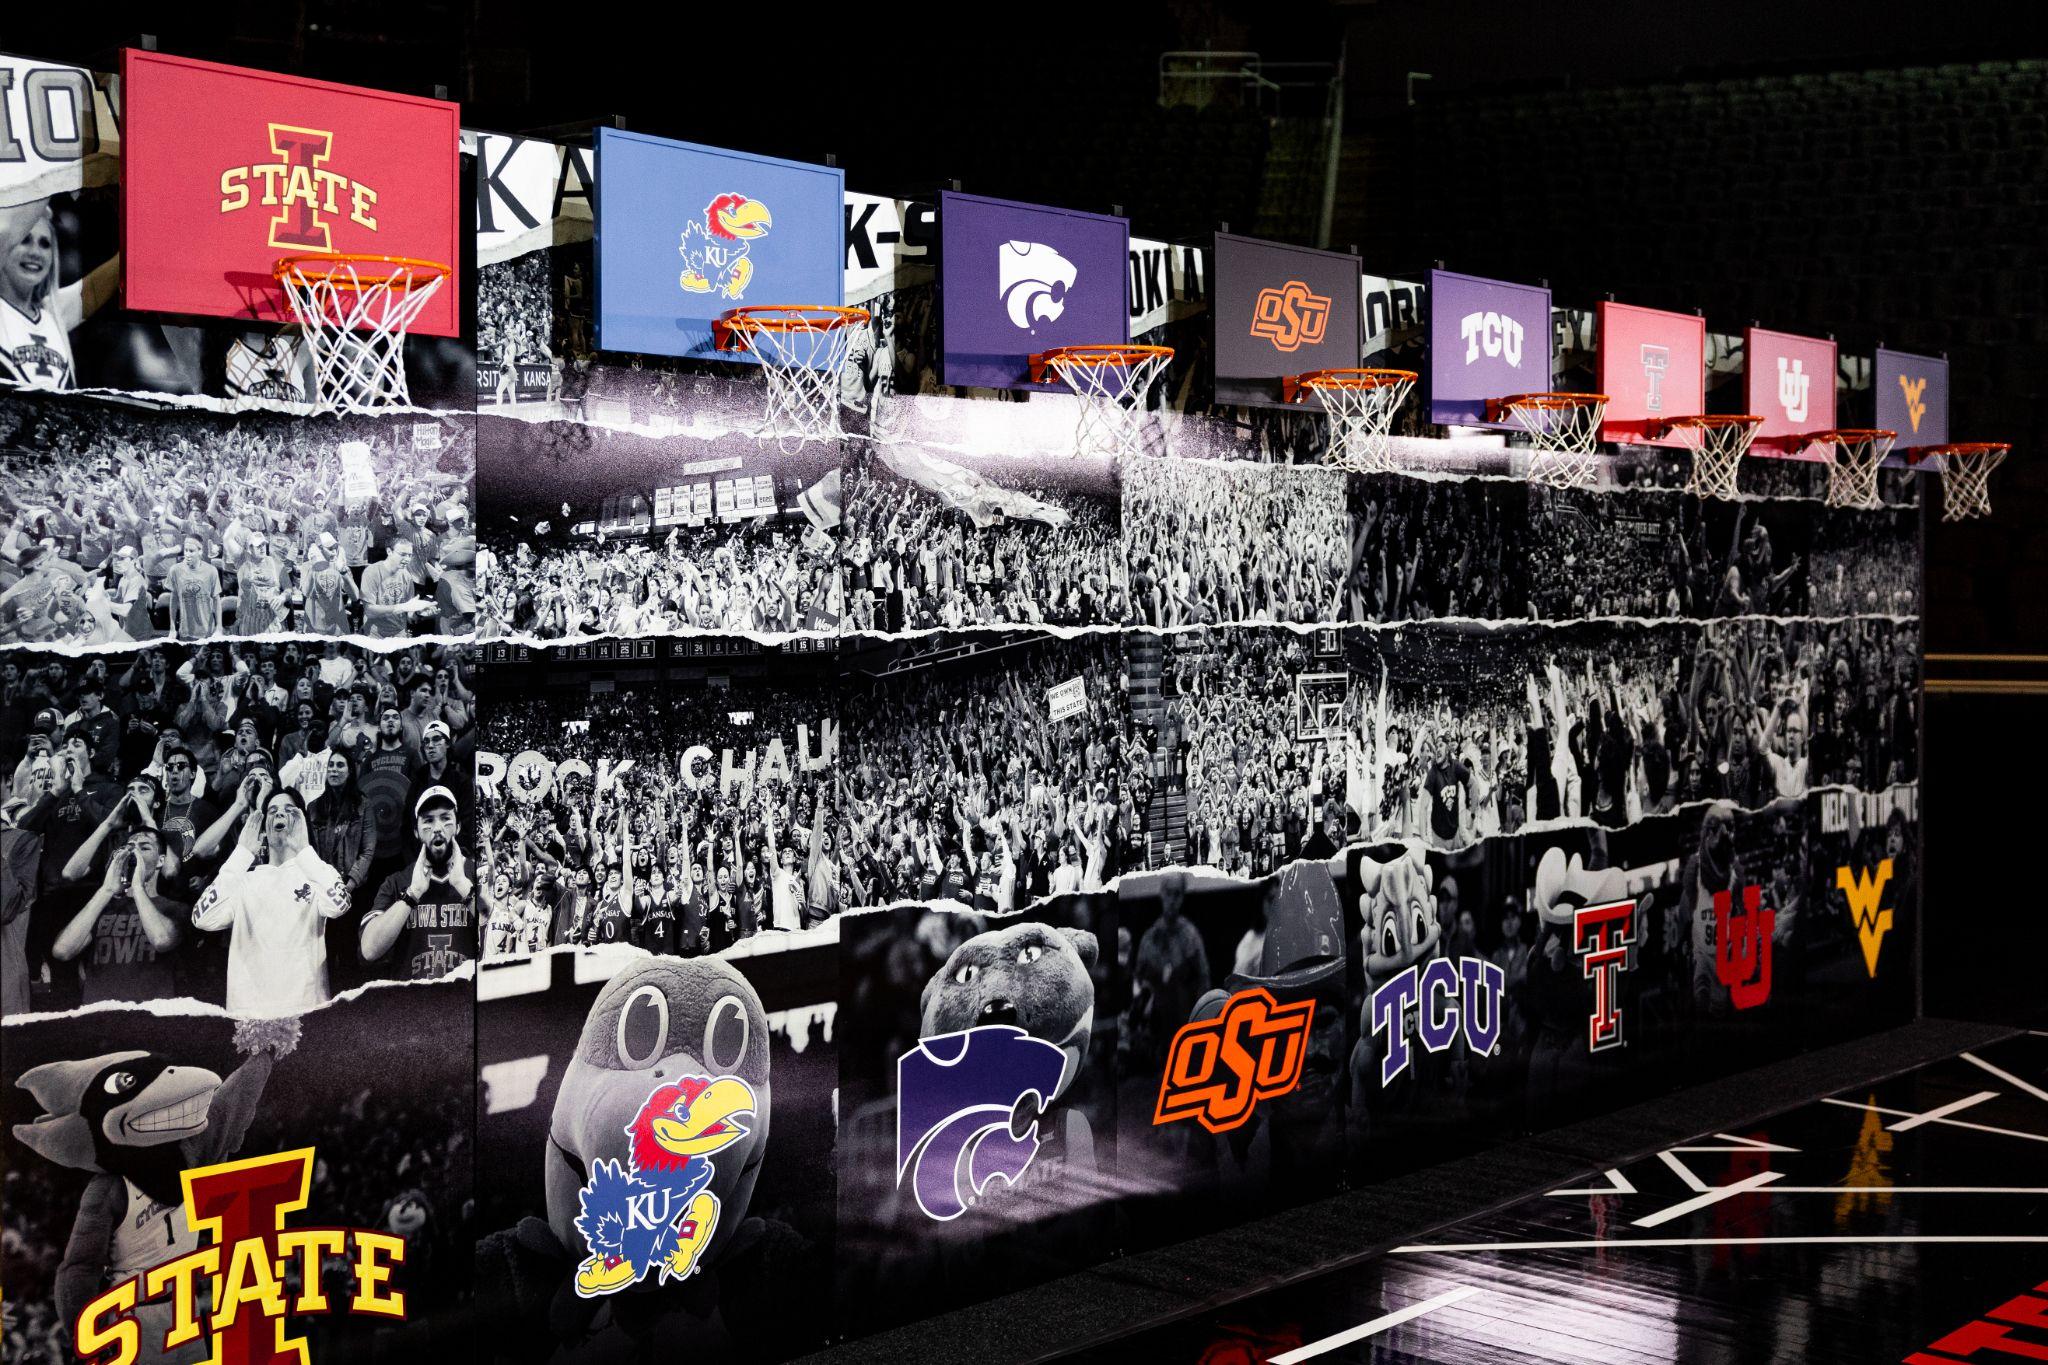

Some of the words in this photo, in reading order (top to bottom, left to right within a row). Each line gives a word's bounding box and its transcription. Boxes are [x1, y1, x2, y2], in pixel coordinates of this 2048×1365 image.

[220, 163, 379, 232] STATE
[704, 246, 728, 268] KU
[1249, 280, 1332, 352] OSU
[1461, 311, 1524, 368] TCU
[674, 643, 683, 653] 45
[1320, 630, 1336, 652] 30
[1053, 706, 1066, 716] THIS
[1066, 699, 1083, 711] STATE
[605, 921, 615, 939] 0
[654, 920, 665, 938] 4
[1837, 859, 1894, 979] WV
[1372, 956, 1505, 1089] TCU
[1152, 988, 1316, 1134] OSU
[625, 1188, 673, 1231] KU
[75, 1228, 406, 1365] STATE
